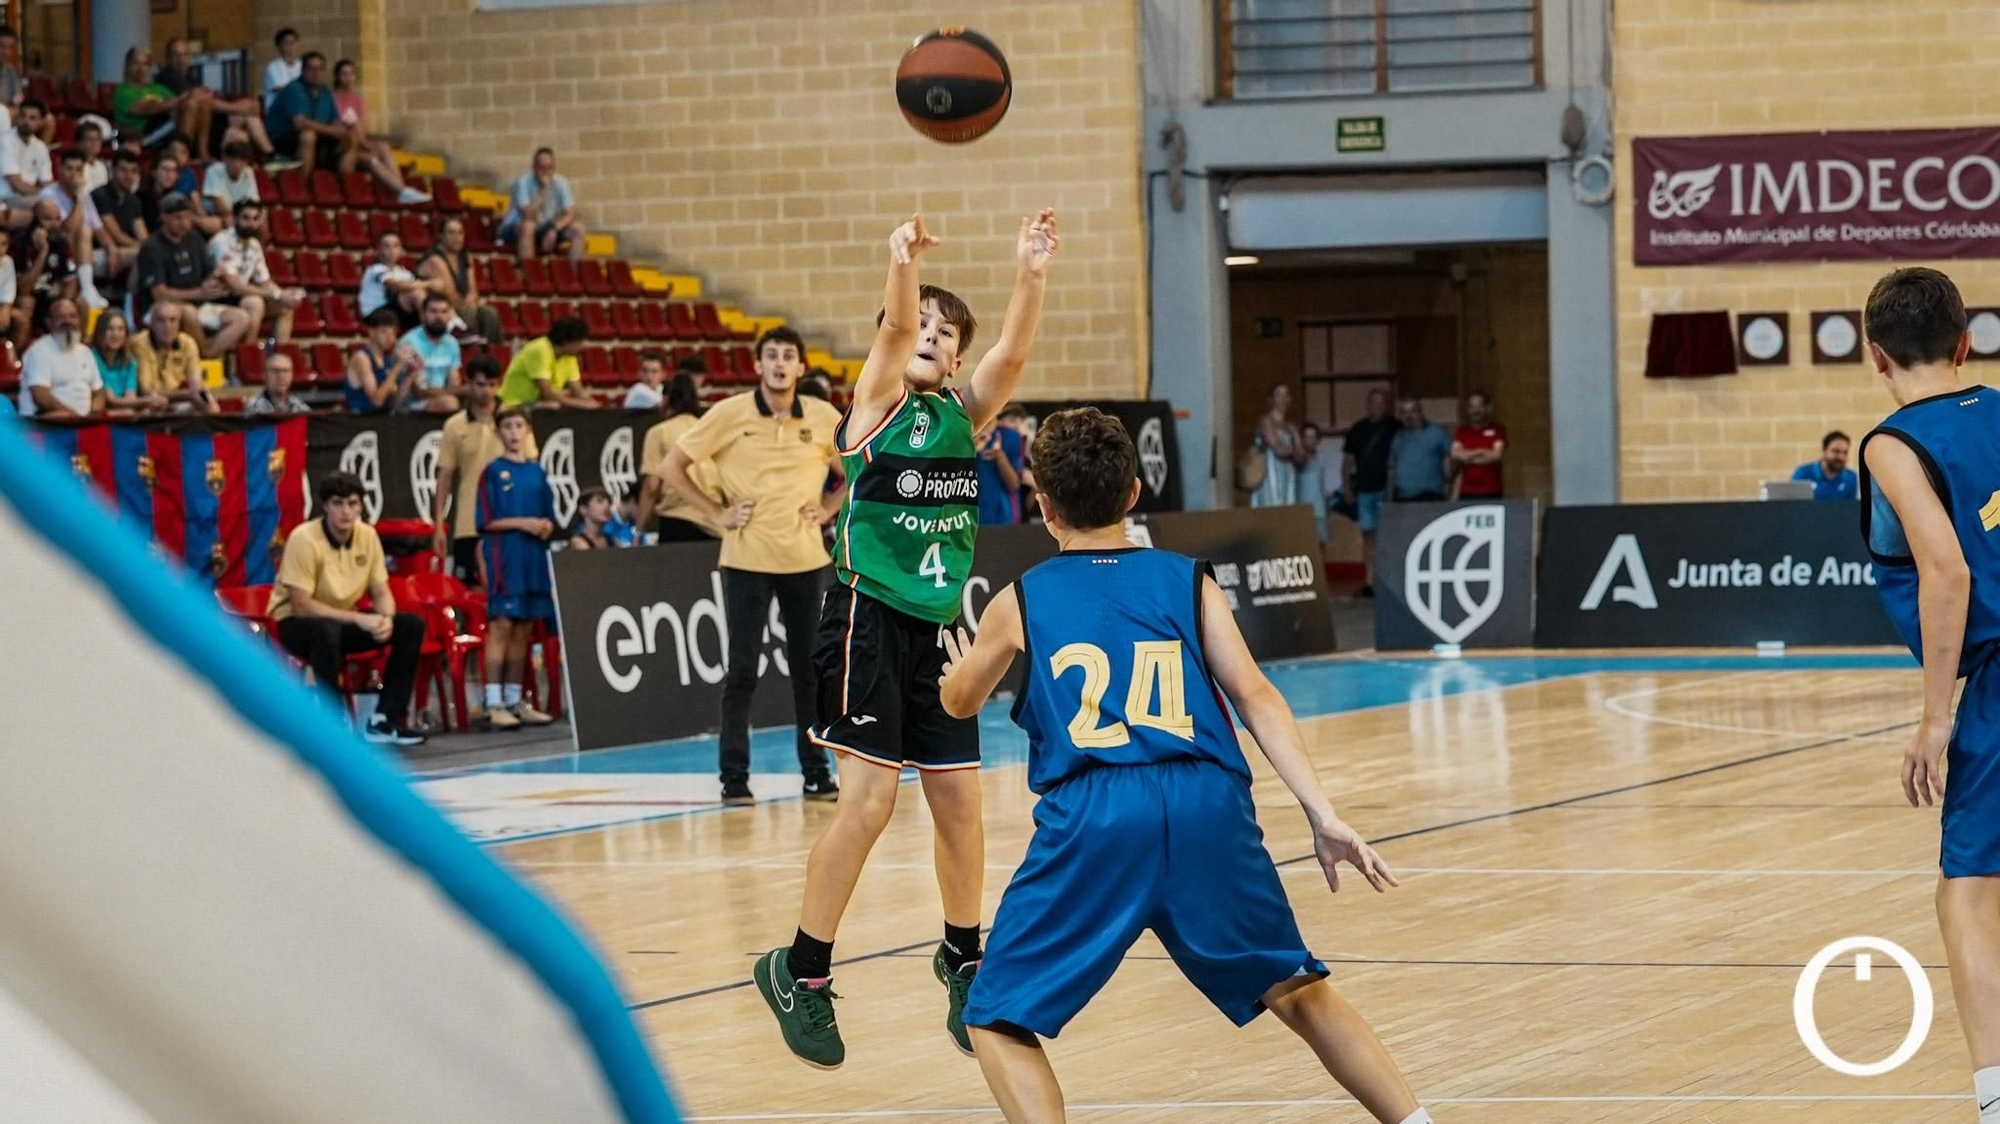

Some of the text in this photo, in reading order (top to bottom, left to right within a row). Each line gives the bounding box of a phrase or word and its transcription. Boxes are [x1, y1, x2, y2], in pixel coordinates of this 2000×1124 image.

[1730, 155, 2000, 216] IMDECO
[1650, 227, 1722, 246] Instituto
[1723, 225, 1811, 247] Municipal
[1812, 224, 1837, 242] de
[1840, 222, 1923, 244] Deportes
[918, 542, 947, 588] 4
[1668, 558, 1762, 588] Junta
[1770, 555, 1812, 586] de
[1050, 640, 1195, 748] 24
